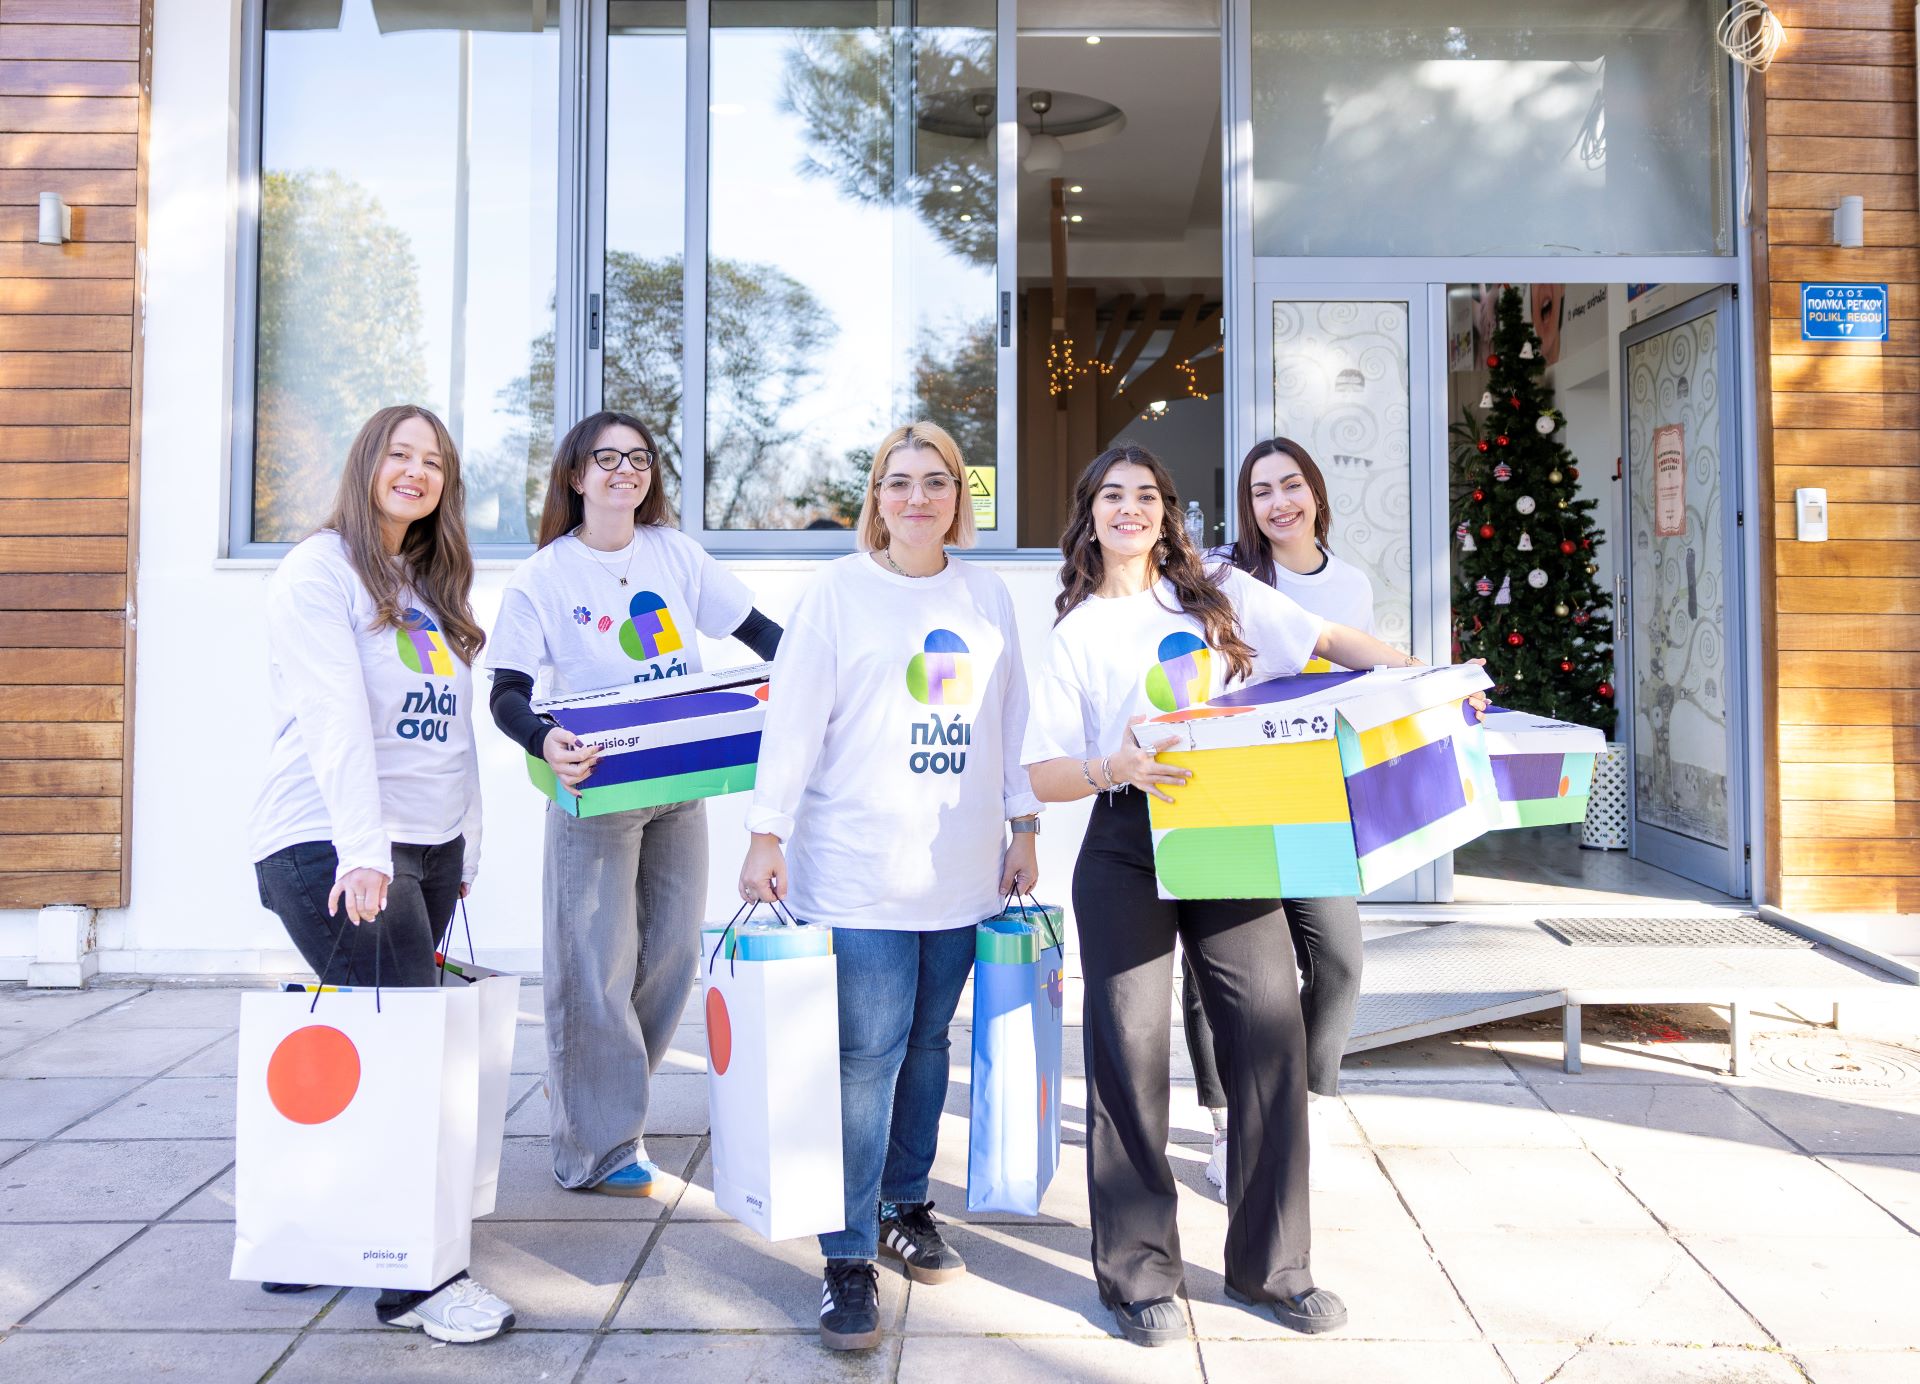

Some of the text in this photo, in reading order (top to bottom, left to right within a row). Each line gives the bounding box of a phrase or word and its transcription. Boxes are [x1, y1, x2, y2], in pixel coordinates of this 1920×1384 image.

[1826, 289, 1863, 298] ΟΔΟΣ
[1808, 298, 1882, 311] ΠΟΛΥΚΛ. ΡΕΓΚΟΥ
[1847, 312, 1882, 323] REGOU
[1837, 323, 1855, 334] 17
[401, 681, 457, 717] πλάι
[396, 718, 449, 742] σου
[911, 713, 971, 746] πλάι
[909, 751, 966, 774] σου
[363, 1249, 408, 1261] plaisio.gr
